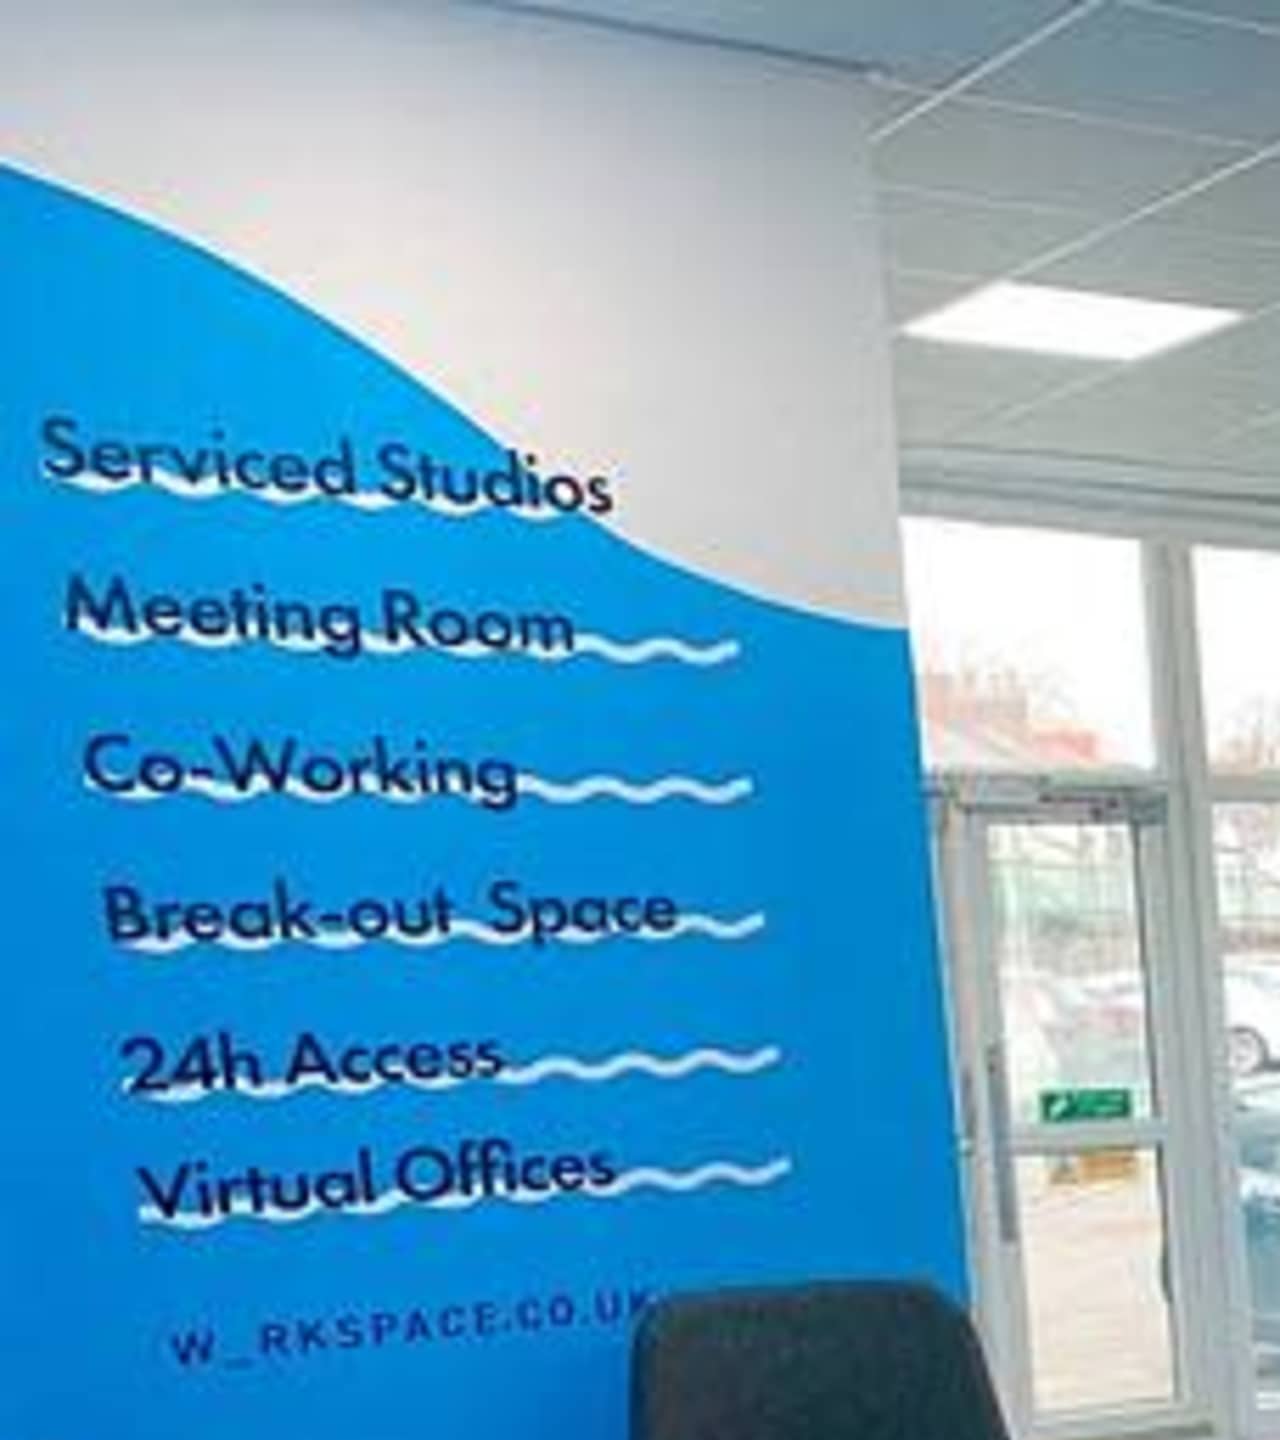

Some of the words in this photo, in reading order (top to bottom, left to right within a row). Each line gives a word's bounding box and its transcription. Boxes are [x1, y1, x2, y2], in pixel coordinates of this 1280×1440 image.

[42, 417, 355, 498] Serviced
[376, 441, 615, 516] Studios
[64, 572, 364, 660] Meeting
[380, 588, 577, 652] Room
[83, 734, 519, 812] Co-Working
[102, 877, 454, 943] Break-out
[486, 880, 680, 945] Space
[120, 1031, 264, 1093] 24h
[286, 1033, 504, 1086] Access
[136, 1147, 378, 1219] Virtual
[398, 1136, 617, 1200] Offices
